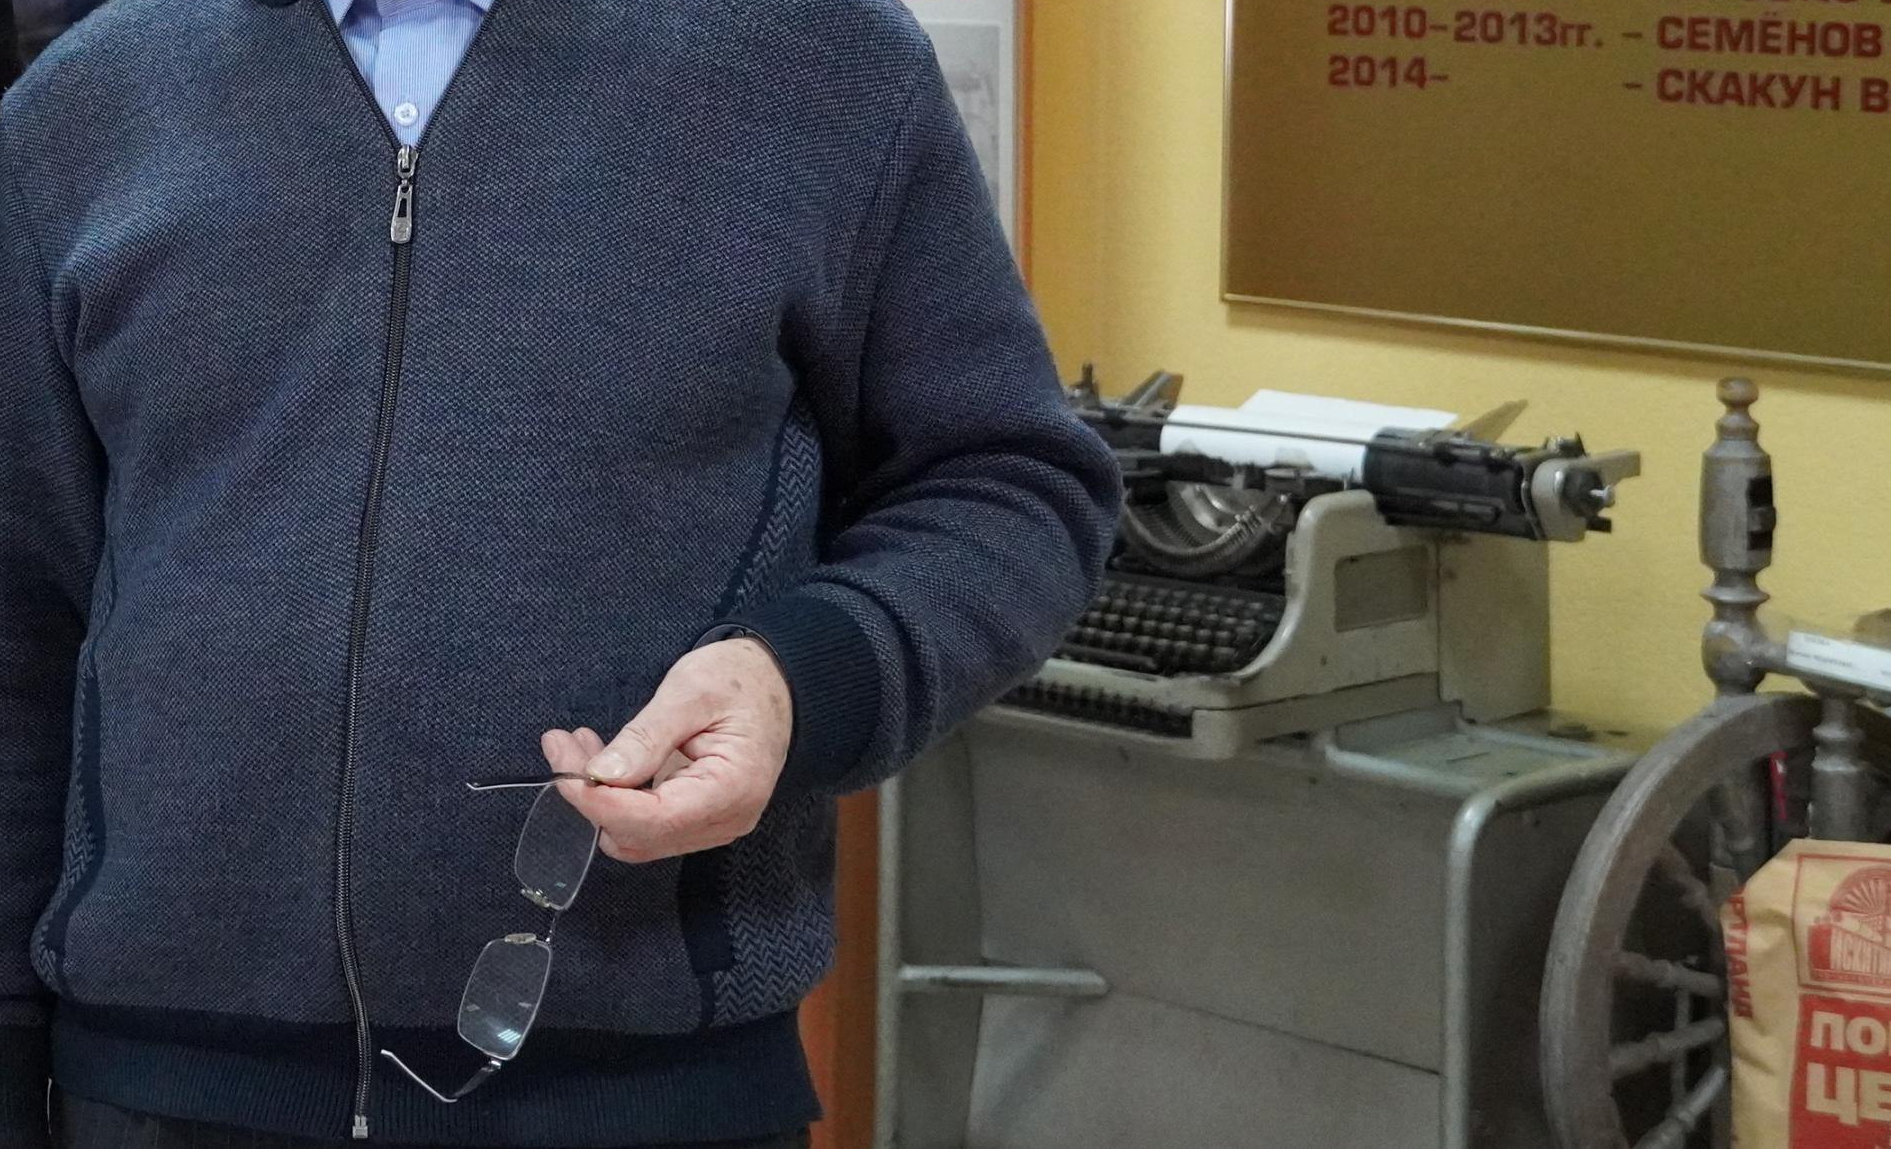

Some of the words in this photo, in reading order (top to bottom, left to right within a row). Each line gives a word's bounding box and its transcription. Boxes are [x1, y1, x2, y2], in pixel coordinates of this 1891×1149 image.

[1659, 11, 1883, 58] СЕМЁНОВ
[1658, 68, 1841, 110] СКАКУН
[1810, 1010, 1891, 1055] ПО
